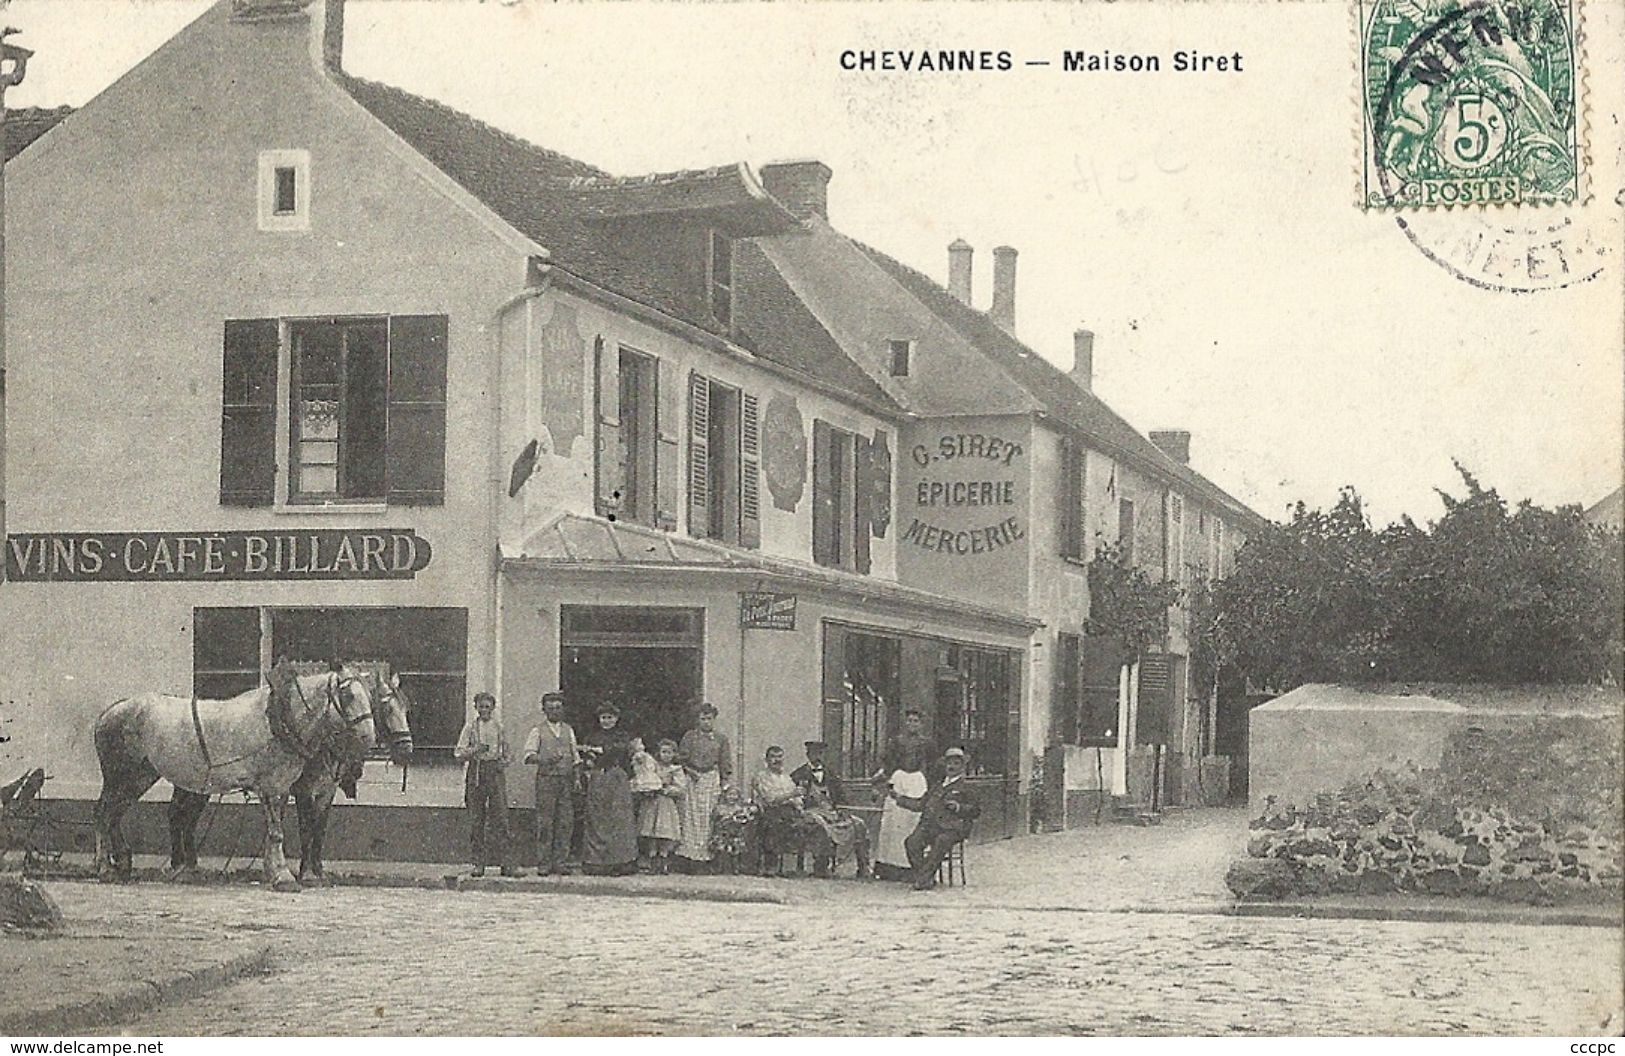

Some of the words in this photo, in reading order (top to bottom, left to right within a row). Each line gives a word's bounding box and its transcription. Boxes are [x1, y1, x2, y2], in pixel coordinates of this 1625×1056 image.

[1424, 181, 1517, 203] POSTES
[917, 477, 1014, 507] ÉPICERIE
[901, 516, 1025, 555] MERCERIE
[7, 537, 103, 576] VINS
[123, 532, 226, 575] CAFÉ
[243, 534, 418, 575] BILLARD
